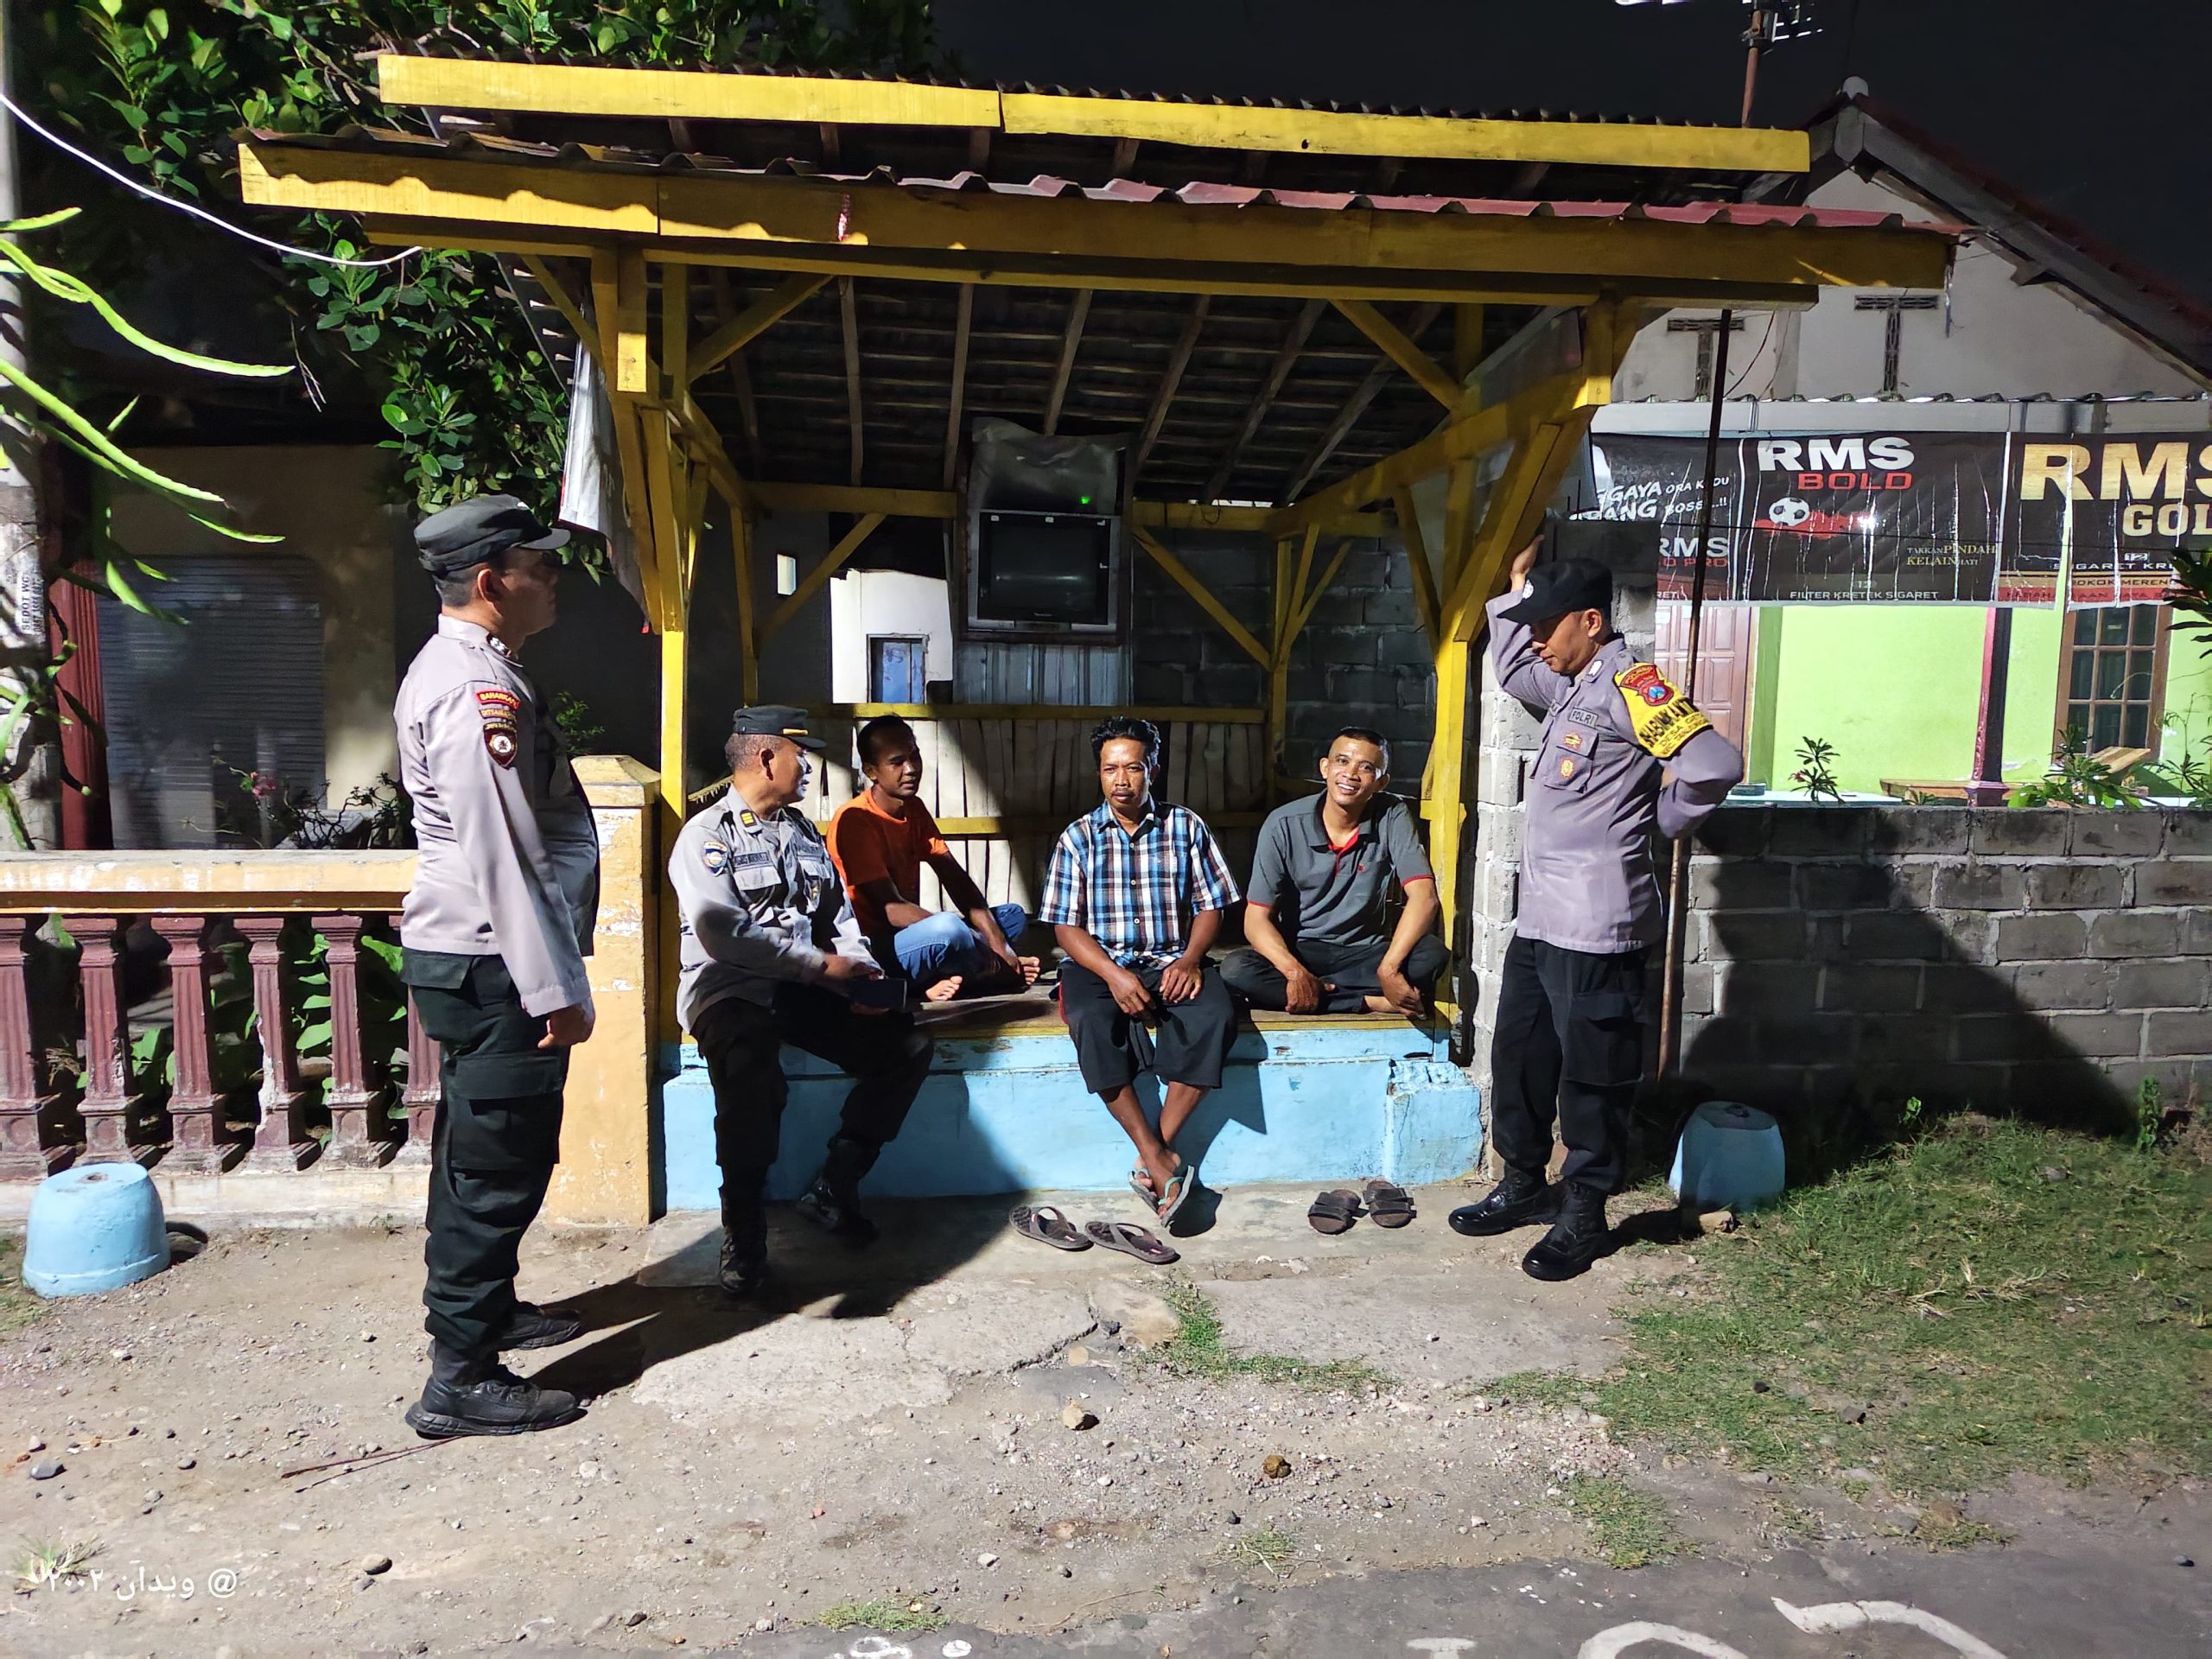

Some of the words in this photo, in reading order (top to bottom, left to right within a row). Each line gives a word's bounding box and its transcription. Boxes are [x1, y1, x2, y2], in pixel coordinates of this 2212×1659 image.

[1758, 437, 1915, 471] RMS
[1695, 476, 1730, 490] KDU
[1798, 472, 1912, 490] BOLD
[1790, 591, 1831, 600] FILTER
[1834, 591, 1883, 600] KRETEK
[1885, 591, 1940, 600] SIGARET
